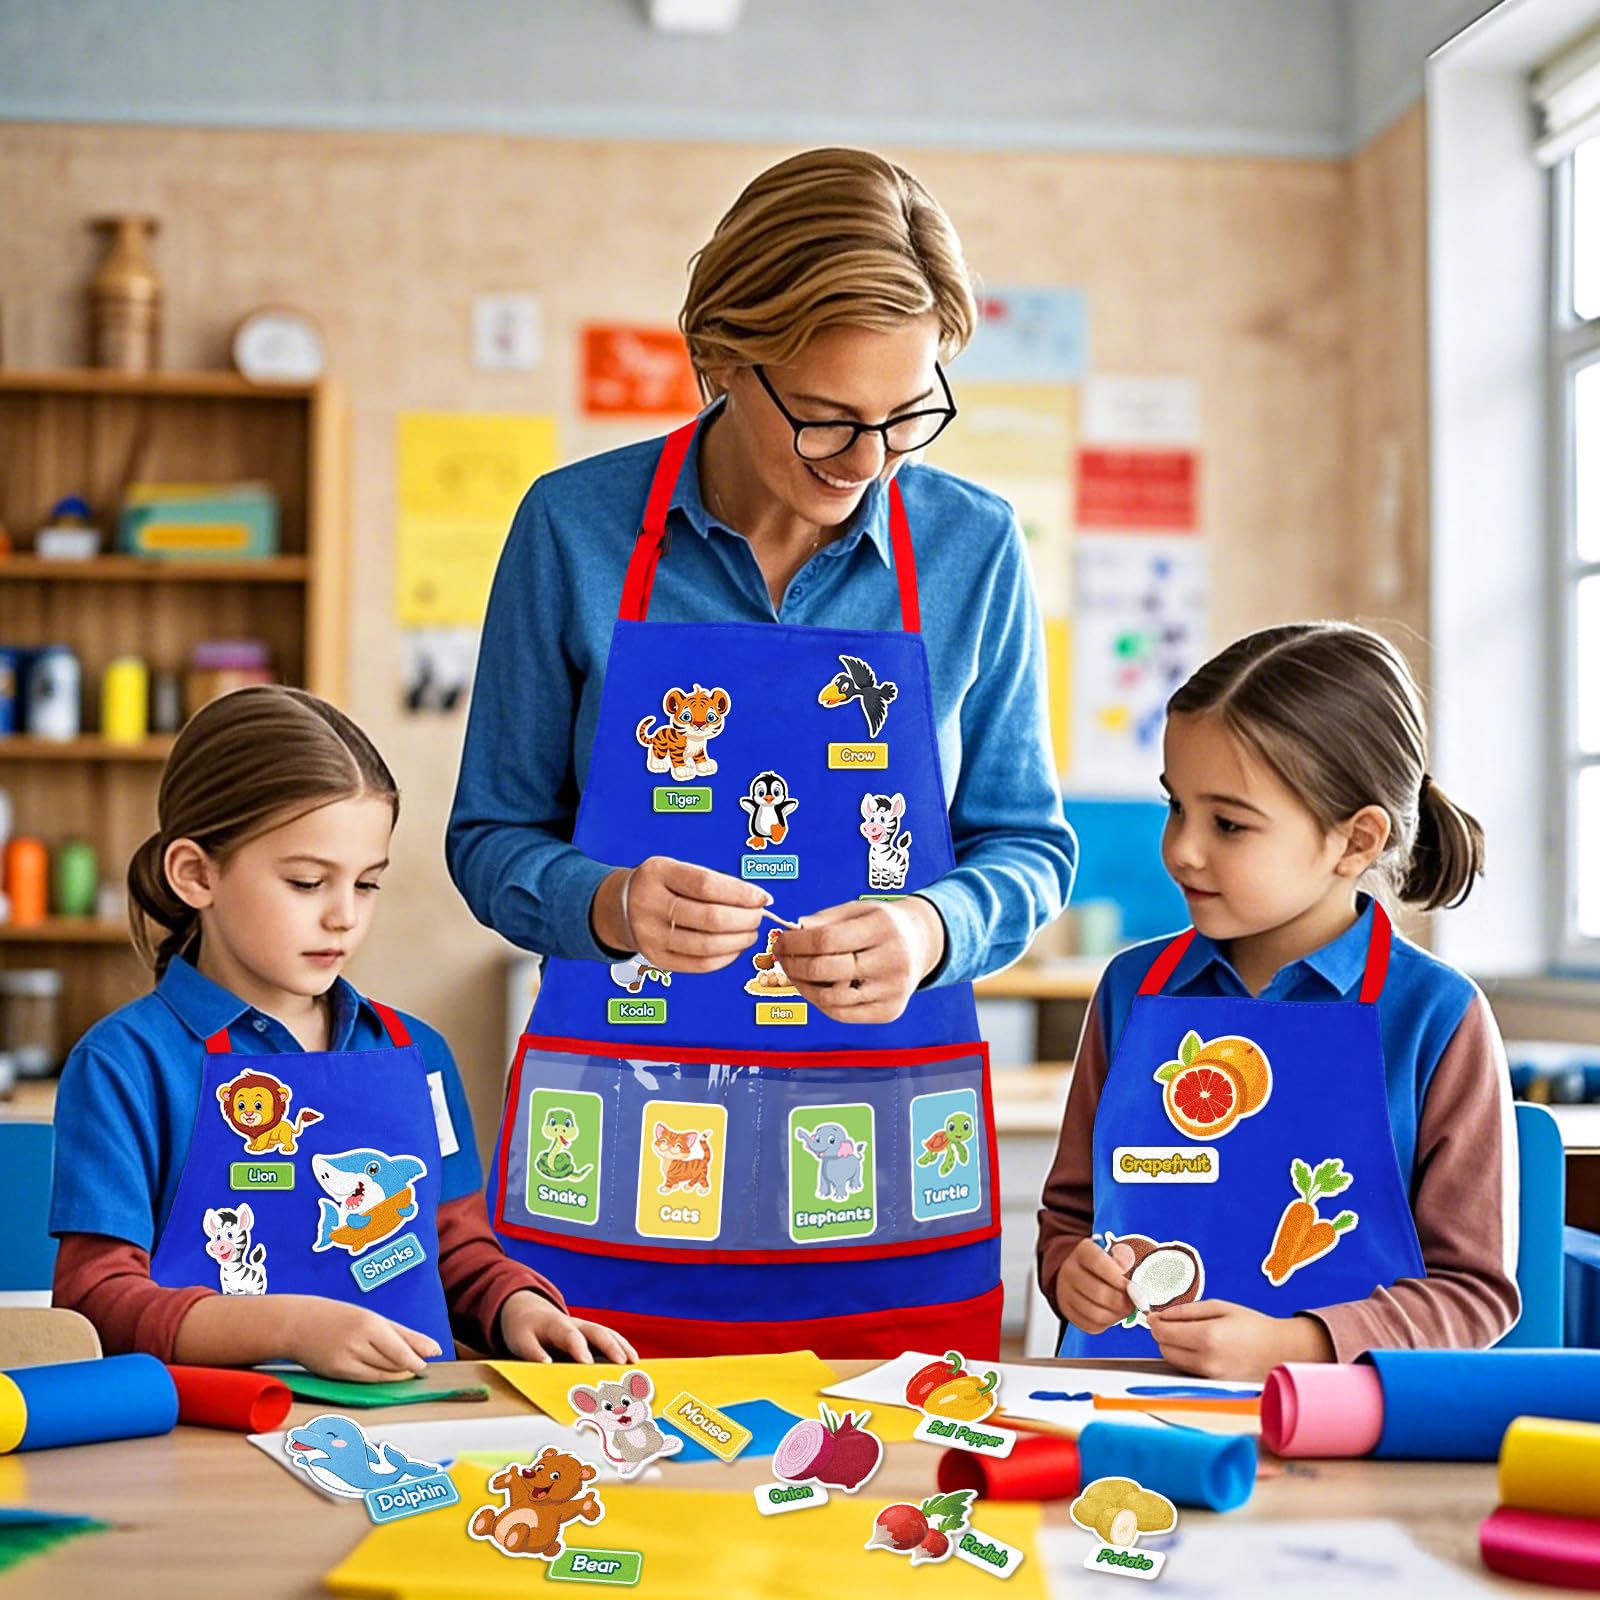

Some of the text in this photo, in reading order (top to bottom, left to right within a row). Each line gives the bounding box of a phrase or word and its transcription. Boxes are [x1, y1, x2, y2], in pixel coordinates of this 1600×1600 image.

[841, 748, 875, 762] Crow
[666, 792, 700, 808] Tiger
[746, 860, 794, 875] Penguin
[619, 1004, 655, 1017] Koala
[770, 1008, 793, 1019] Hen
[1120, 1153, 1212, 1177] Grapefruit
[248, 1169, 277, 1183] Lion
[537, 1185, 588, 1207] Snake
[923, 1184, 970, 1205] Turtle
[659, 1205, 701, 1224] Cats
[795, 1207, 872, 1229] Elephants
[361, 1245, 415, 1280] Sharks
[678, 1401, 732, 1444] Mouse
[927, 1420, 1004, 1448] Bell Pepper
[376, 1482, 448, 1513] Dolphin
[769, 1486, 814, 1504] Onion
[959, 1533, 1009, 1568] Radish
[1096, 1549, 1154, 1571] Potato
[571, 1555, 620, 1574] Bear
